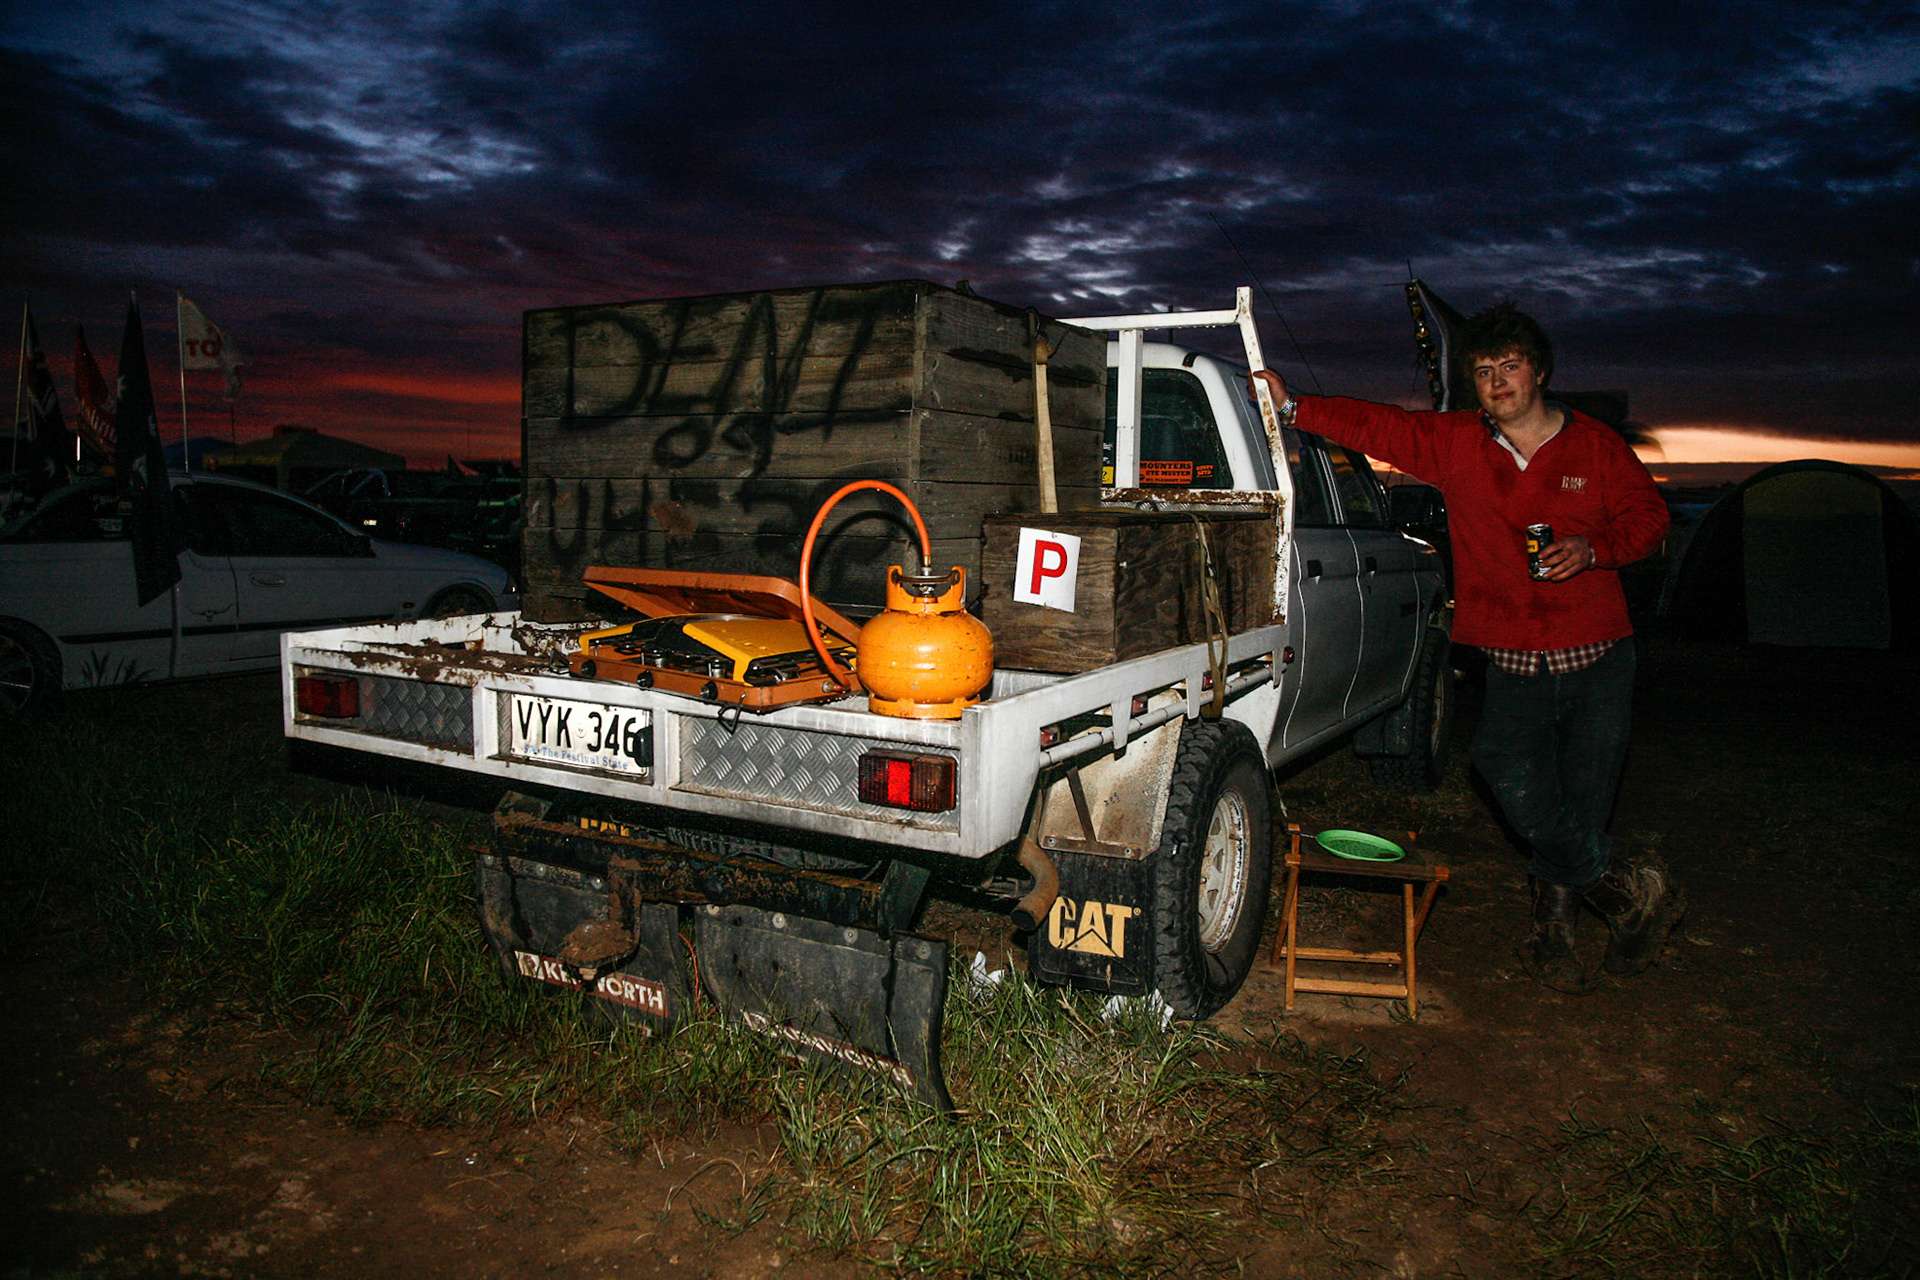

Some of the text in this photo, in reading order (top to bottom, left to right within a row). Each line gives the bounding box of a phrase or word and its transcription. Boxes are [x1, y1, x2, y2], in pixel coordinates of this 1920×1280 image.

[1031, 539, 1068, 595] P
[517, 699, 637, 758] VYK 346
[561, 749, 600, 765] Festival
[602, 756, 629, 770] State
[1047, 895, 1133, 959] CAT
[543, 959, 664, 1011] KEWORTH
